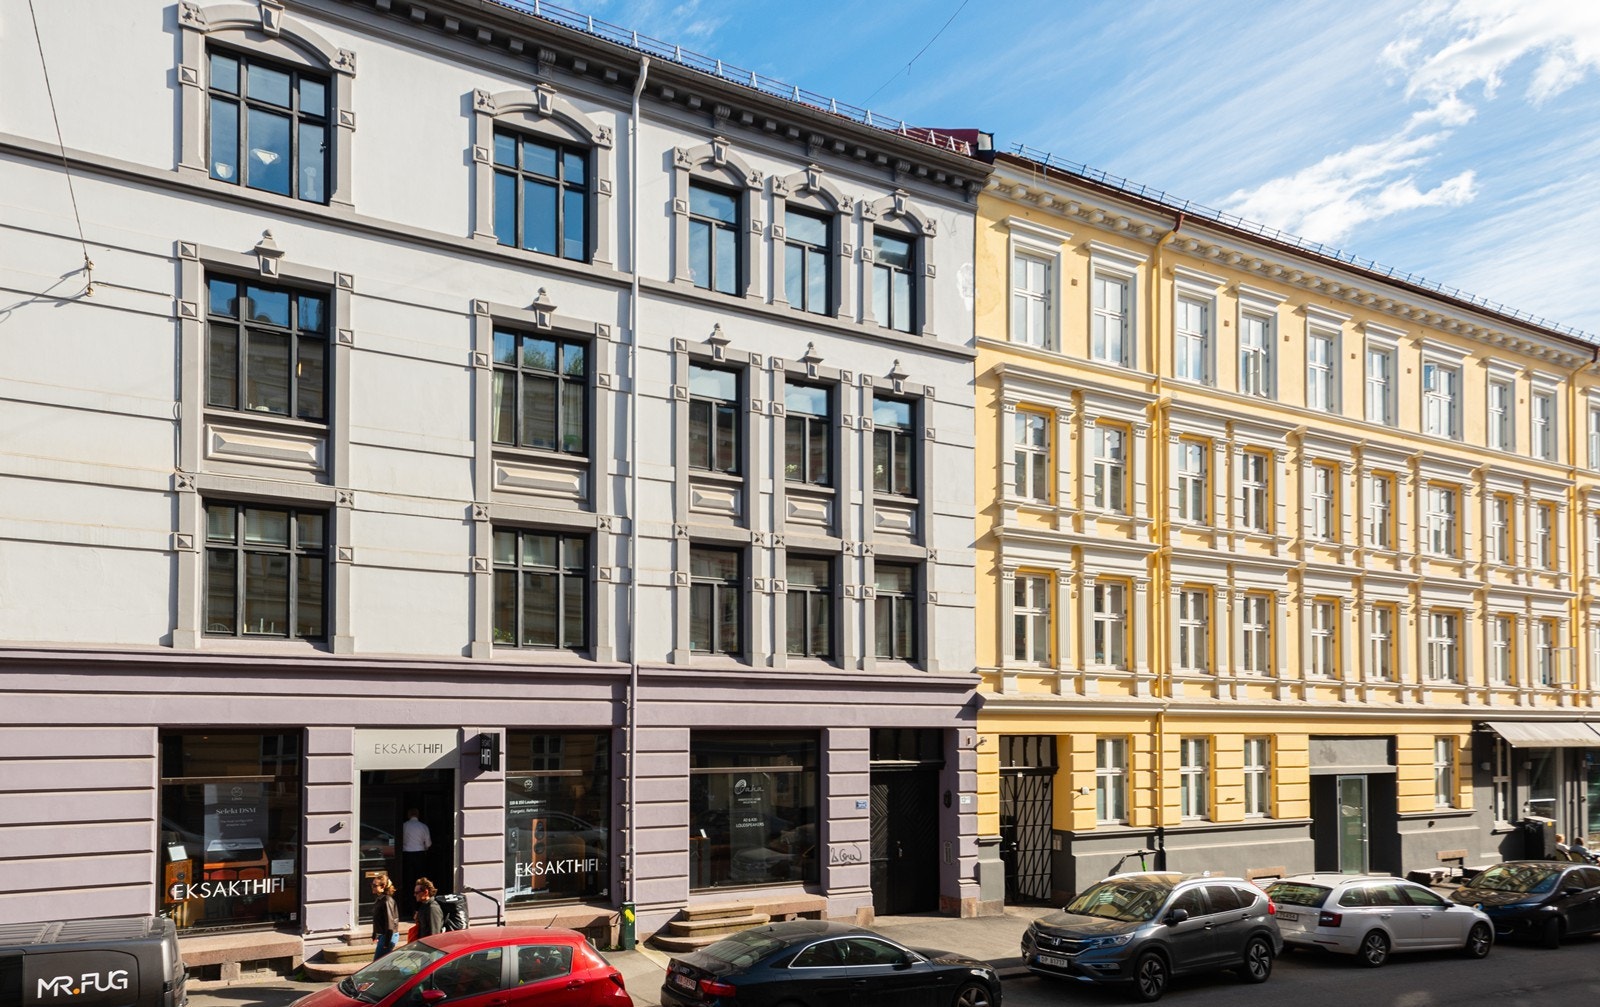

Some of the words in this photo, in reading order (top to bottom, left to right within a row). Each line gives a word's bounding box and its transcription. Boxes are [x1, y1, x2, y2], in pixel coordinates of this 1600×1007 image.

[374, 743, 443, 755] EKSAKTHIFI
[515, 858, 599, 876] EKSAKTHIFI
[173, 877, 285, 901] EKSAKTHIFI
[37, 969, 128, 999] MR.FUG
